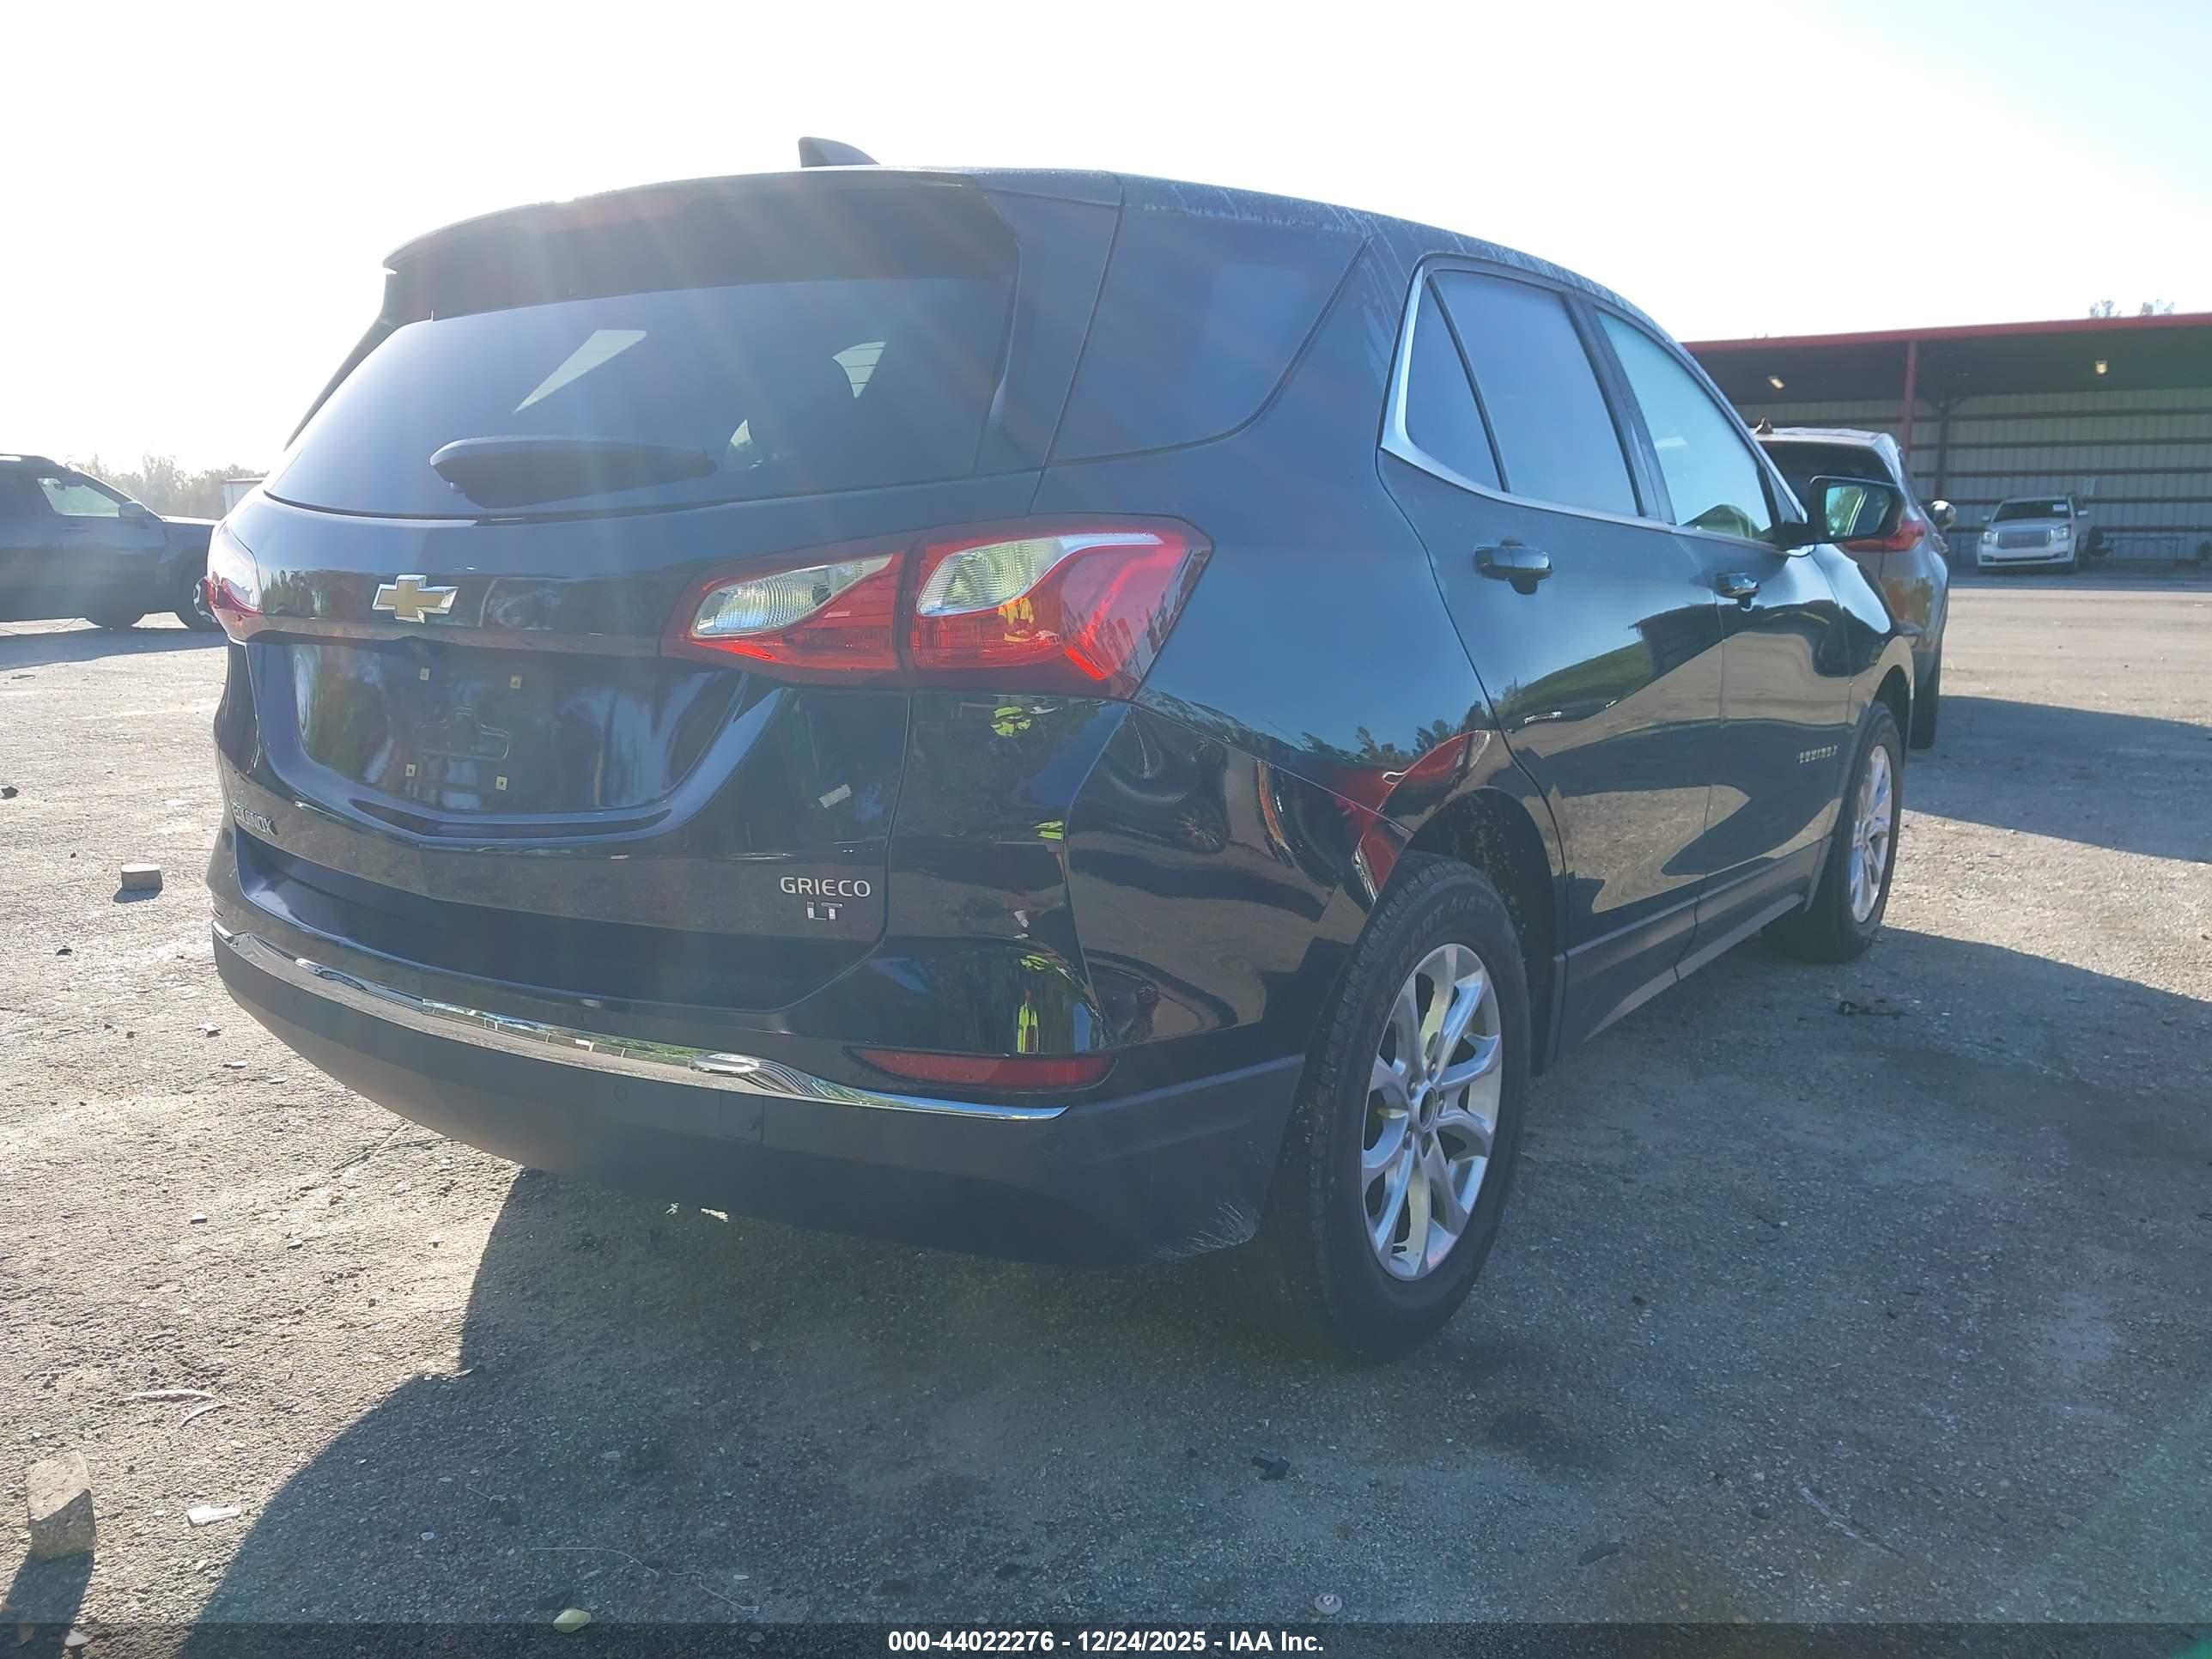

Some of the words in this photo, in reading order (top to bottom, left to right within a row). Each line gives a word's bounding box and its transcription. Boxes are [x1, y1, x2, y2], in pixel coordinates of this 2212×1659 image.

[232, 801, 276, 837] EQUINOX
[780, 876, 872, 898] GRIECO
[806, 901, 843, 921] LT
